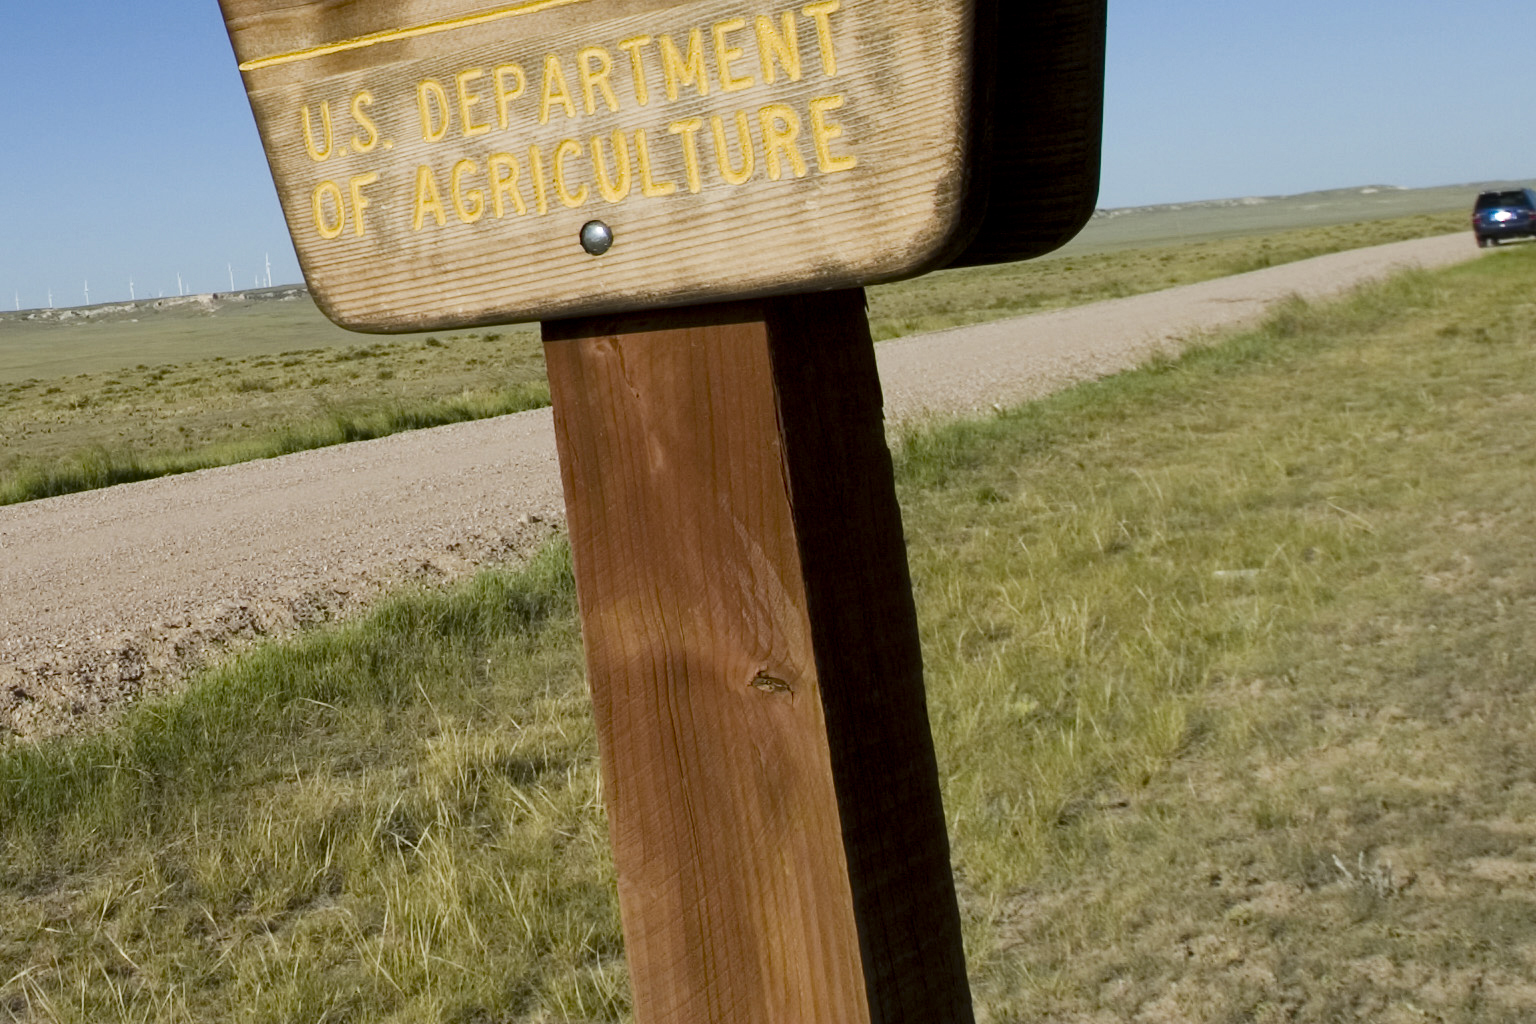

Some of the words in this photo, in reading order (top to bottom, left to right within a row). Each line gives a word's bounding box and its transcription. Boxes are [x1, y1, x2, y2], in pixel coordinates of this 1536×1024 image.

[301, 91, 394, 162] U.S.
[311, 172, 377, 239] OF
[413, 95, 857, 231] AGRICULTURE
